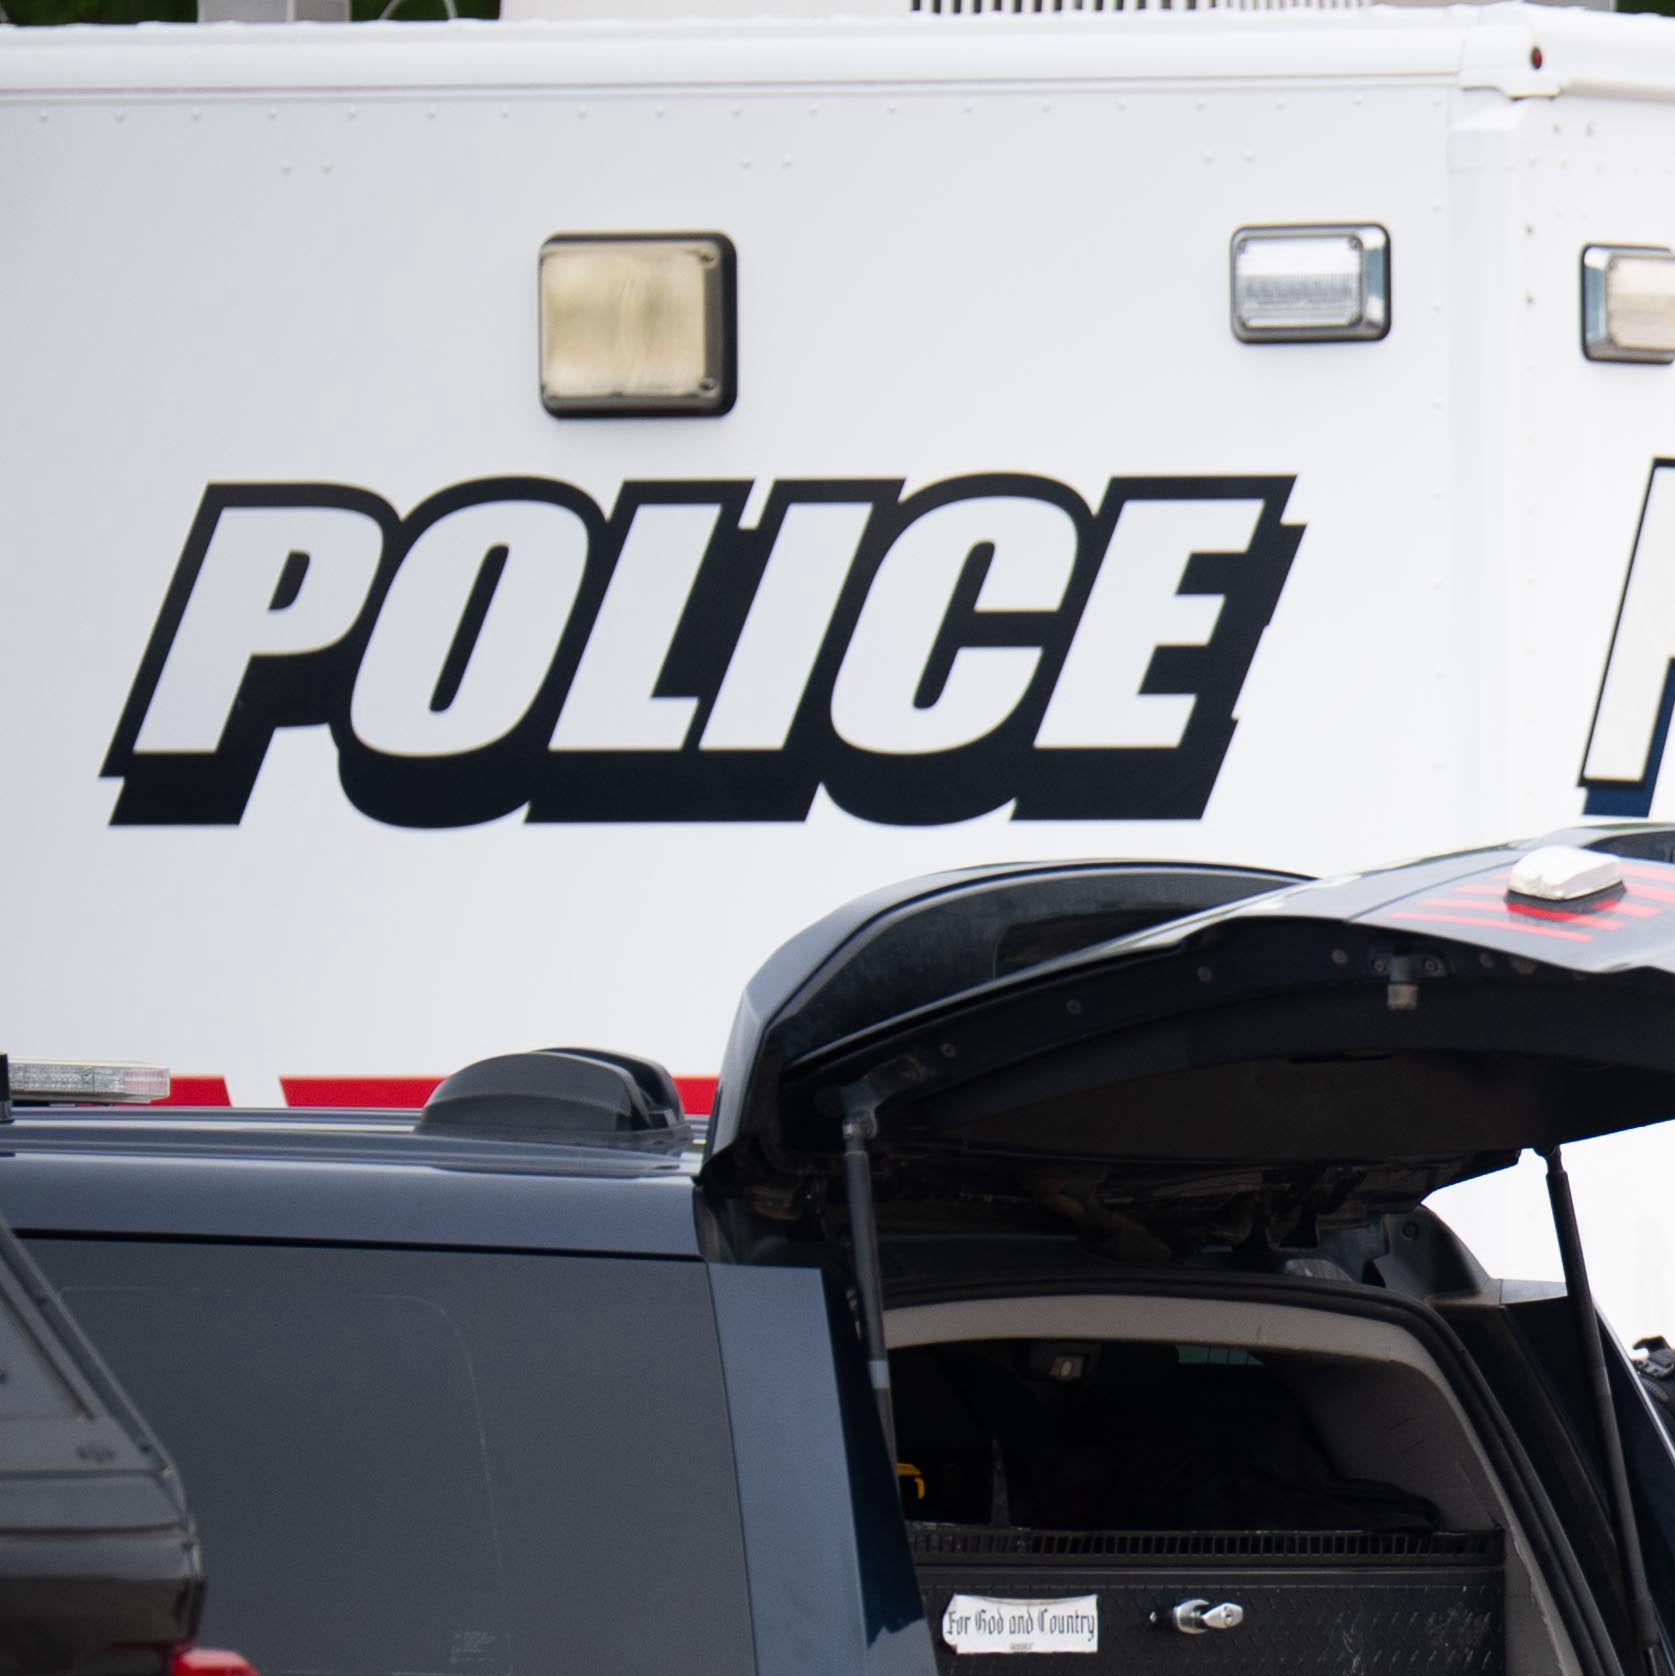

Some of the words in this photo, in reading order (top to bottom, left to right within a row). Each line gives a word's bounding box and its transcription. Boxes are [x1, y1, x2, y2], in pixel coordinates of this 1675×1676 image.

[99, 473, 1307, 829] POLICE
[946, 1611, 971, 1636] For
[974, 1607, 1004, 1636] God
[1008, 1605, 1034, 1635] and
[1037, 1608, 1095, 1642] Country
